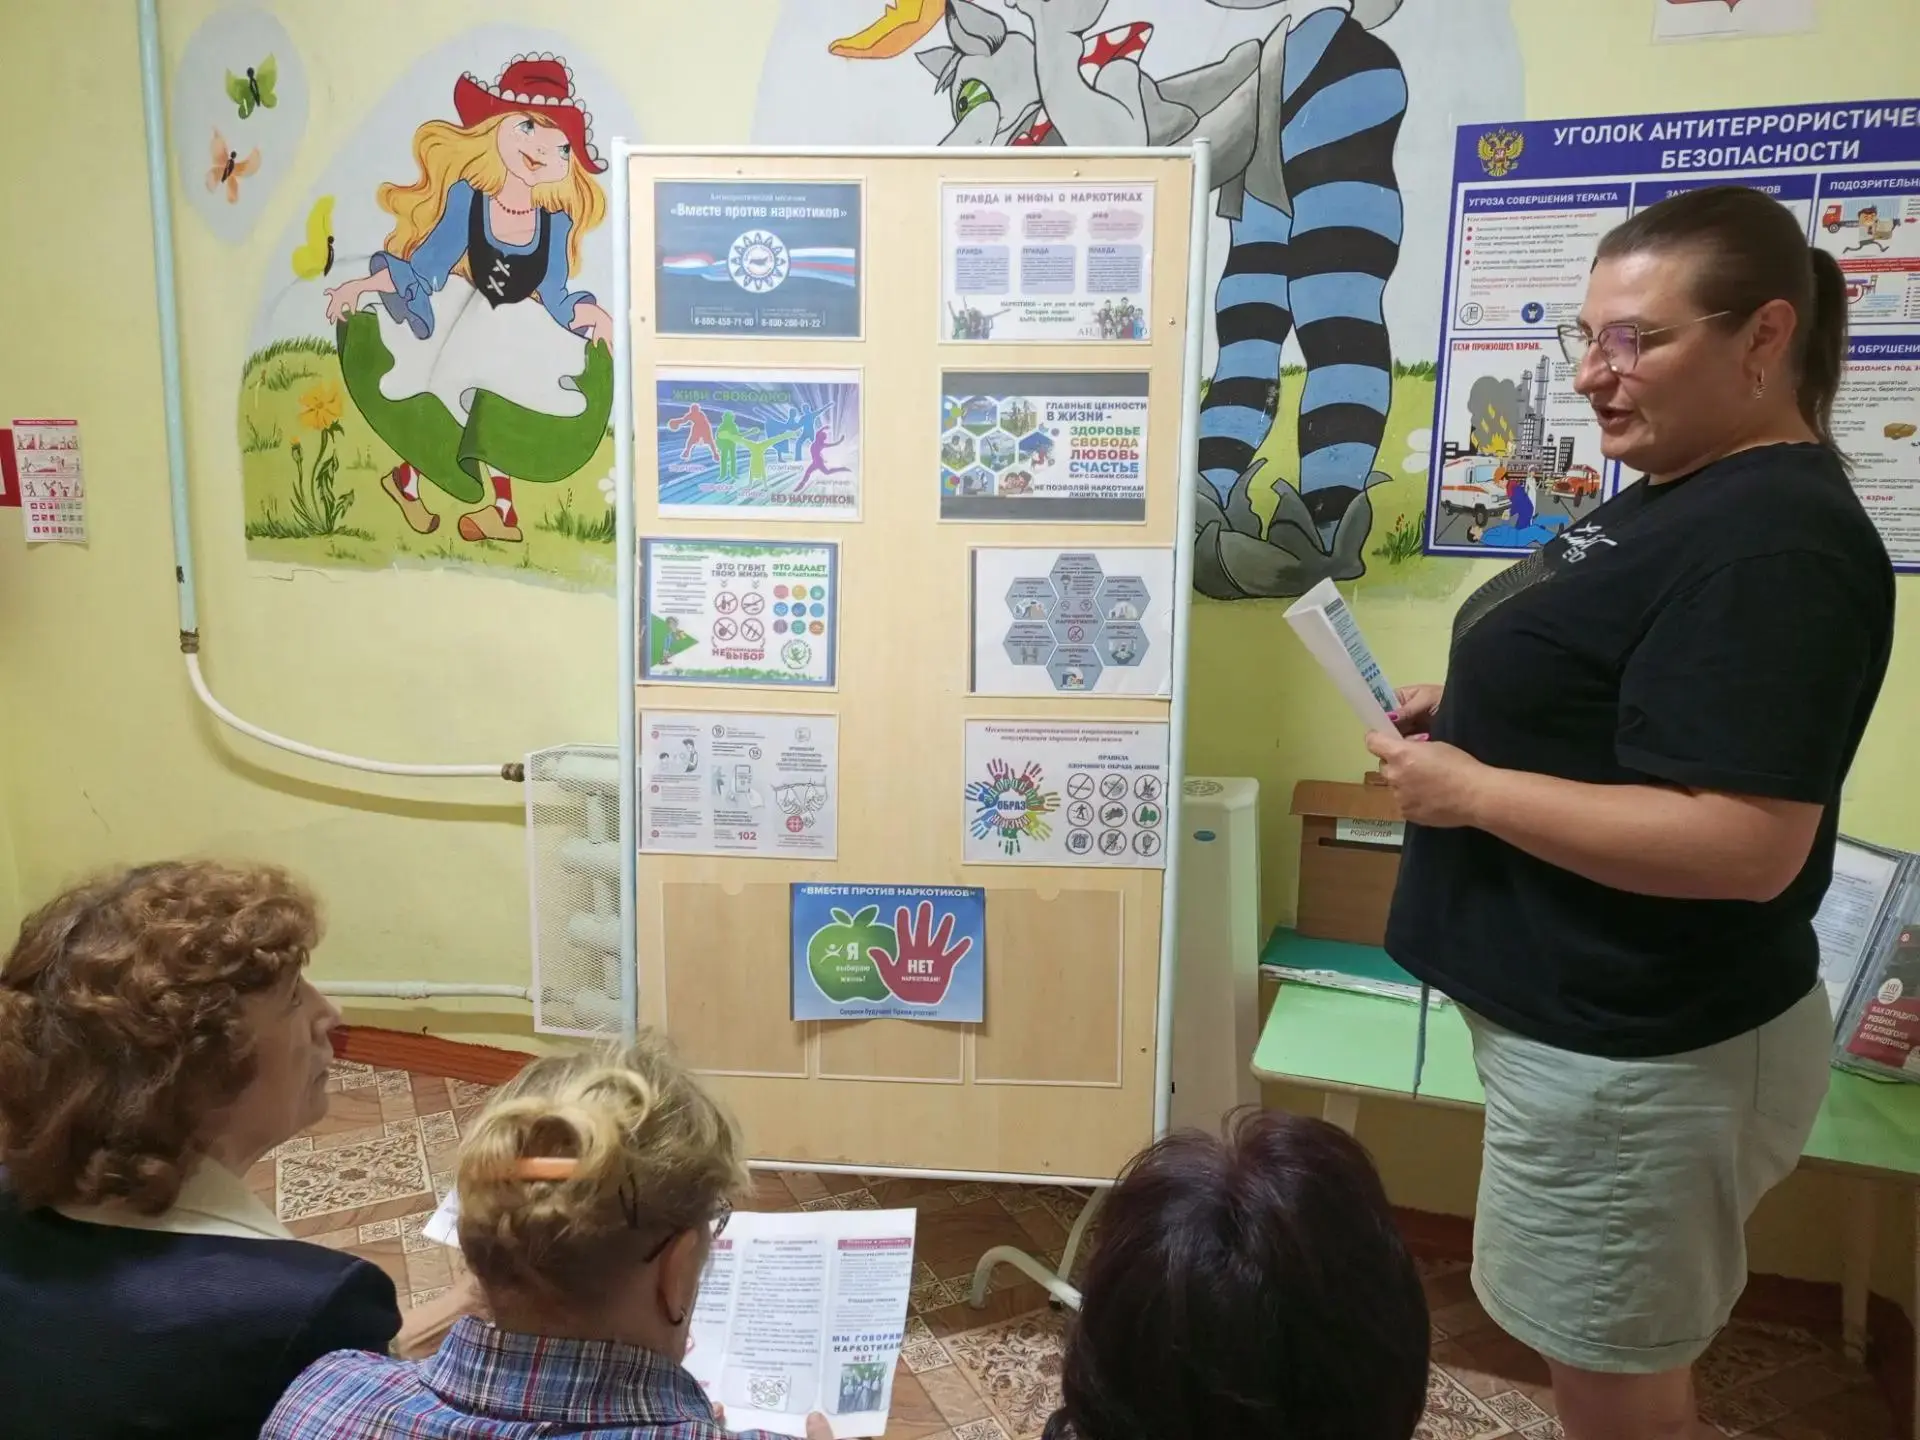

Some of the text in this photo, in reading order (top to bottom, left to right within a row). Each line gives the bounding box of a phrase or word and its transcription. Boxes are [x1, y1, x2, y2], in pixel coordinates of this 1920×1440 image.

[1553, 123, 1645, 146] УГОЛОК
[1660, 140, 1860, 169] БЕЗОПАСНОСТИ
[1829, 177, 1920, 191] ПОДОЗРИТЕЛЬН
[956, 191, 1143, 205] ПРАВДА И МИФЫ О НАРКОТИКАХ
[1468, 191, 1618, 207] УГРОЗА СОВЕРШЕНИЯ ТЕРАКТА
[725, 205, 768, 219] против
[770, 206, 848, 220] наркотиков»
[1453, 342, 1470, 351] ЕСЛИ
[1857, 344, 1920, 354] ОБРУШЕНИ
[672, 389, 711, 401] ЖИВИ
[1045, 402, 1148, 411] ГЛАВНЫЕ ЦЕННОСТИ
[1046, 411, 1055, 421] В
[1057, 411, 1104, 421] ЖИЗНИ
[1069, 426, 1141, 436] ЗДОРОВЬЕ
[1070, 438, 1139, 449] СВОБОДА
[1069, 449, 1140, 461] ЛЮБОВЬ
[1069, 462, 1139, 473] СЧАСТЬЕ
[716, 562, 767, 572] ЭТО ГУБИТ
[772, 563, 828, 573] ЭТО ДЕЛАЕТ
[725, 651, 766, 661] ВЫБОР
[996, 800, 1026, 811] ОБРАЗ
[738, 831, 757, 841] 102
[800, 886, 976, 898] «ВМЕСТЕ ПРОТИВ НАРКОТИКОВ»
[846, 942, 860, 961] Я
[907, 959, 934, 974] НЕТ
[832, 1334, 850, 1342] МЫ
